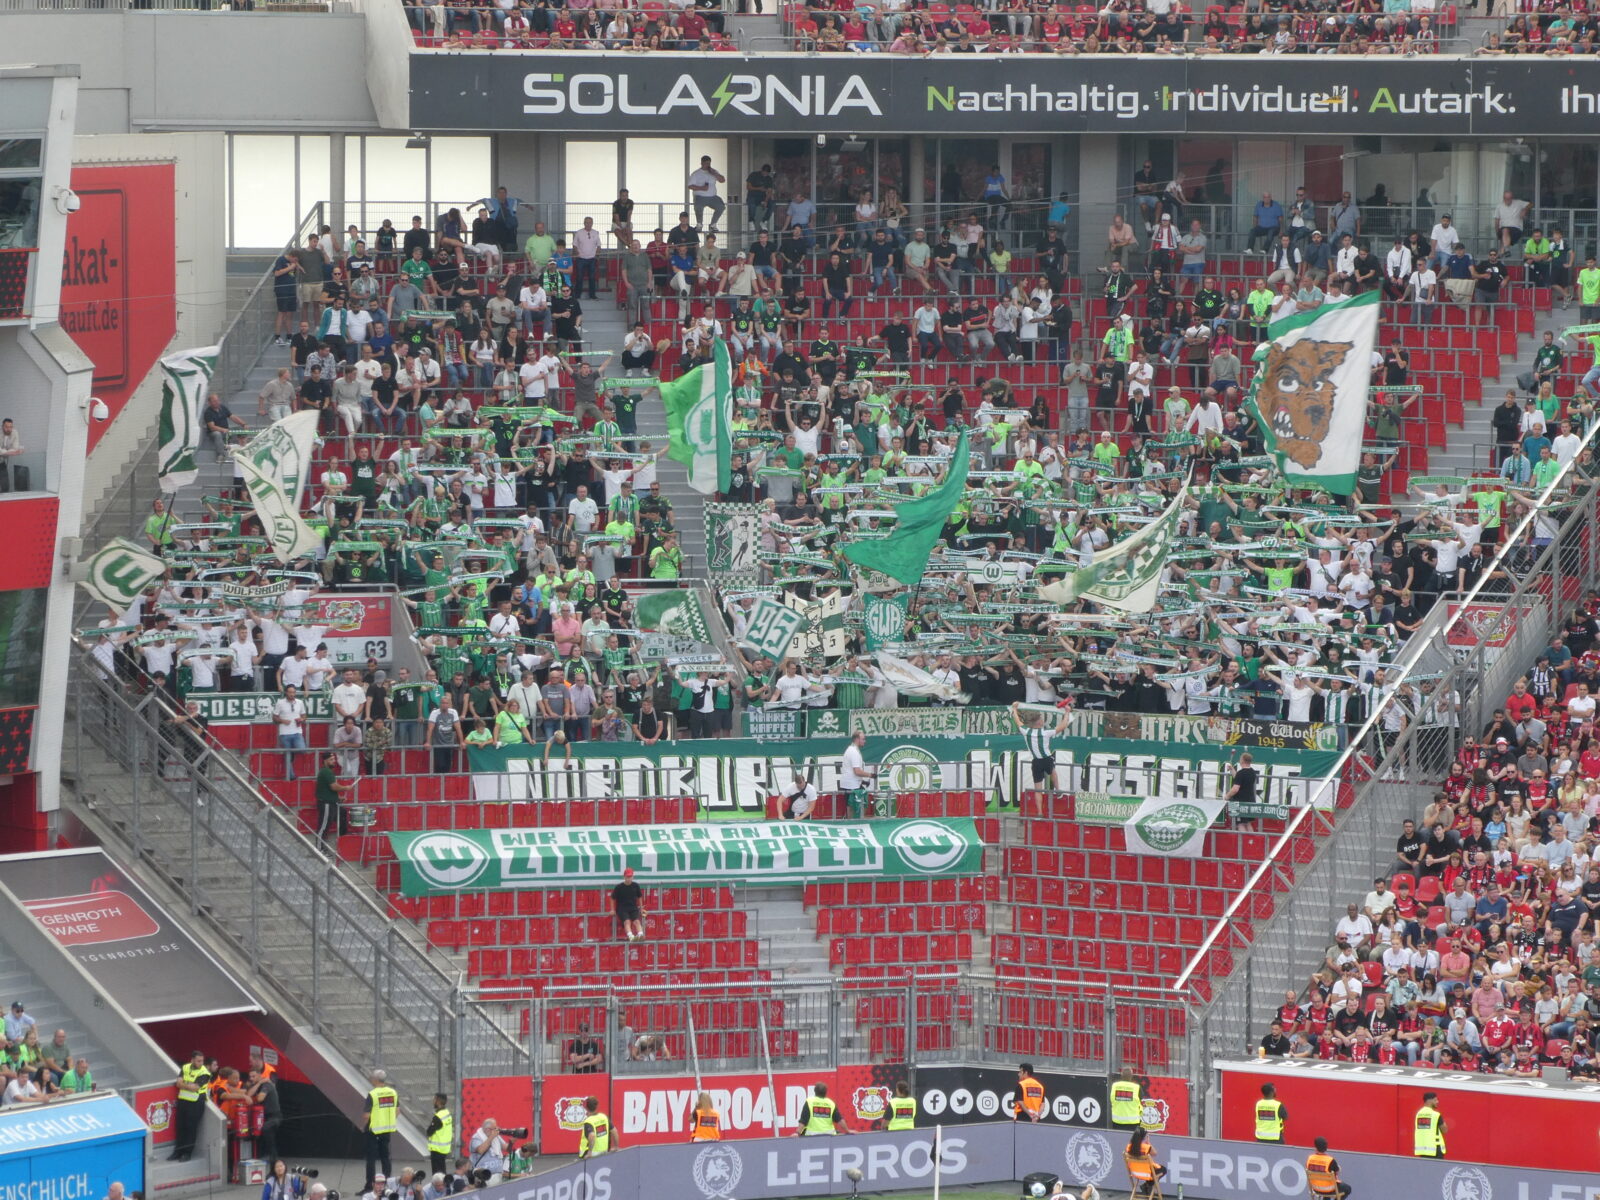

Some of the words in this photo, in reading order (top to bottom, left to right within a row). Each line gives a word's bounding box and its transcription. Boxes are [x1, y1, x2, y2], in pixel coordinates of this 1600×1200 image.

[523, 73, 883, 116] SOLARNIA
[927, 84, 1149, 118] Nachhaltig.
[1161, 84, 1358, 114] Individuell.
[1368, 85, 1516, 114] Autark.
[223, 578, 290, 598] WOLFSBURG
[1257, 736, 1285, 748] 1945
[500, 831, 558, 846] WIR
[568, 827, 708, 845] GLAUBEN
[721, 827, 761, 840] AN
[771, 825, 867, 840] UNSER
[503, 837, 877, 874] ZINNENWAPPEN
